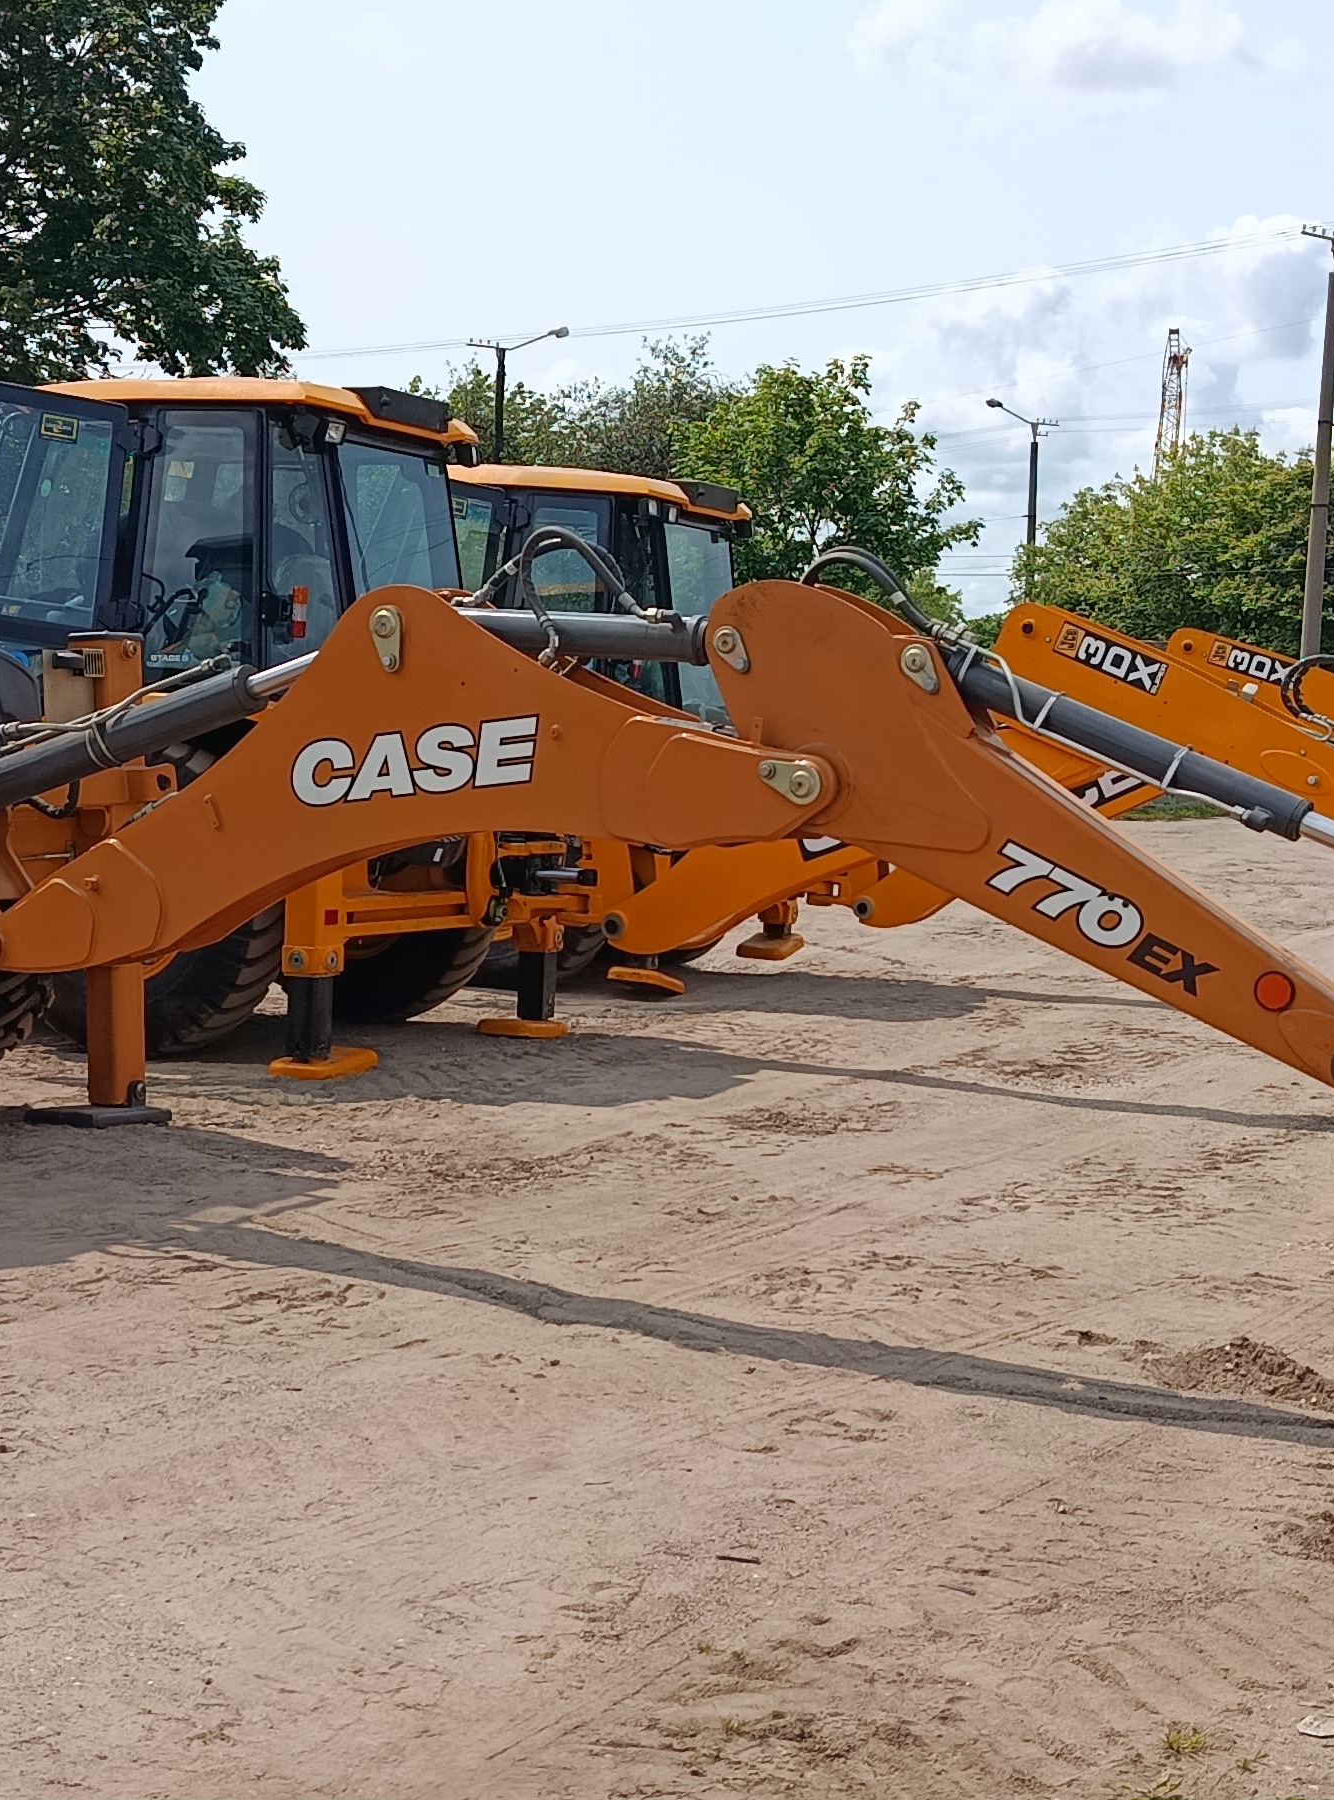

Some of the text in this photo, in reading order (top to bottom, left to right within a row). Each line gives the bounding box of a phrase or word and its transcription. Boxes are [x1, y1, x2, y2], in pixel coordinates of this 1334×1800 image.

[1057, 629, 1078, 650] JCB
[1078, 636, 1161, 691] 3DX
[1228, 649, 1293, 685] 3DX
[290, 713, 539, 807] CASE
